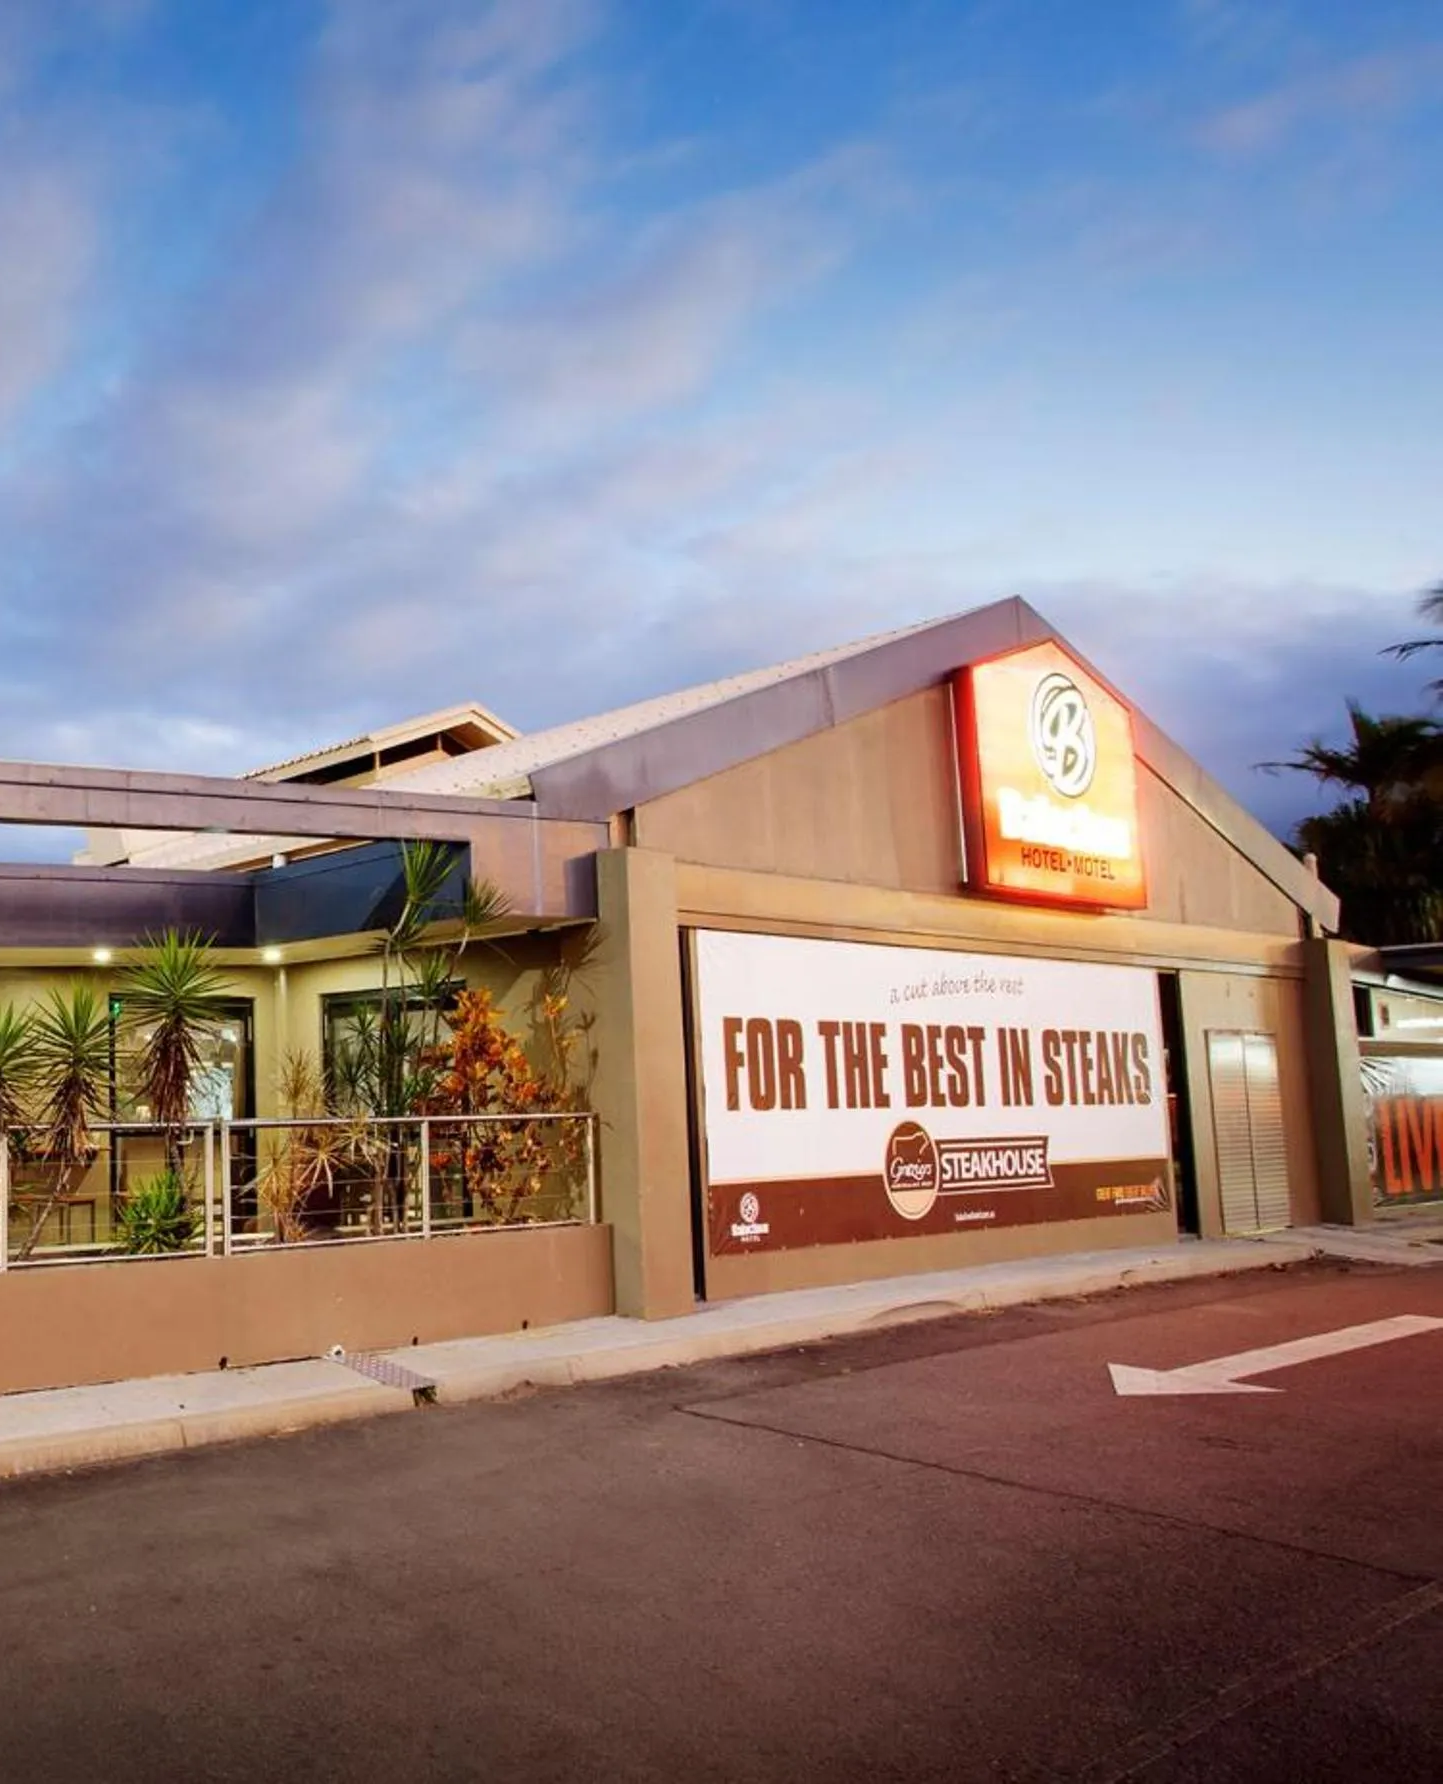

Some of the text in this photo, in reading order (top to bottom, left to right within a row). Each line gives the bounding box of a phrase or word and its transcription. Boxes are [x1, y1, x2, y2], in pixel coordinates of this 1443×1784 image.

[1020, 847, 1116, 880] HOTEL MOTEL
[889, 988, 900, 1004] a
[904, 977, 928, 1001] cut
[931, 971, 970, 996] above
[973, 969, 996, 994] the
[722, 1017, 1151, 1111] FOR THE BEST IN STEAKS
[1379, 1097, 1443, 1194] LIV
[941, 1149, 1046, 1180] STEAKHOUSE
